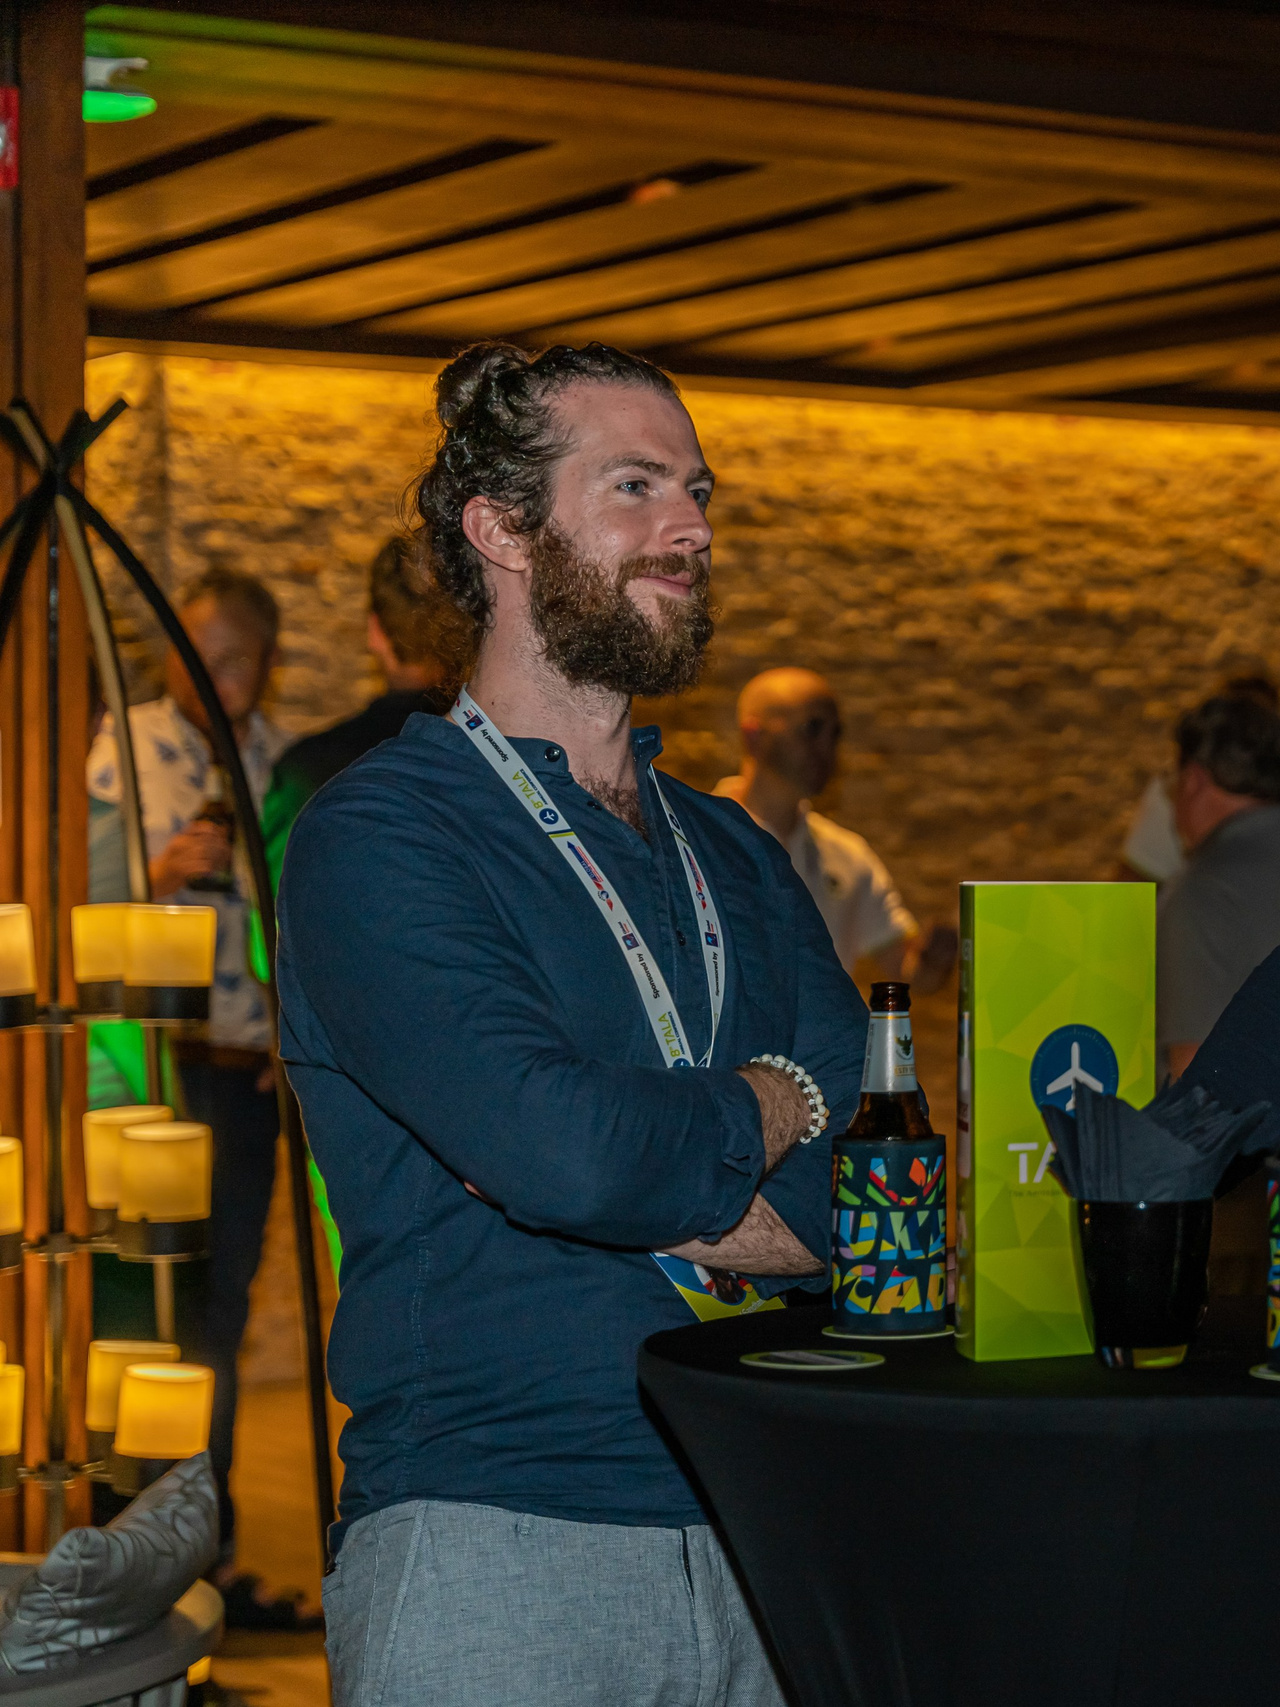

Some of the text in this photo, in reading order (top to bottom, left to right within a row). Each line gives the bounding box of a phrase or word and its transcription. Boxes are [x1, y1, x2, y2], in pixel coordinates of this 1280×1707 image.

[481, 728, 509, 763] Sponsored by
[512, 771, 535, 799] TALA
[636, 953, 660, 999] Sponsored by
[658, 1013, 676, 1046] TALA
[667, 1011, 679, 1038] CONFERENCE
[1007, 1141, 1057, 1184] TA
